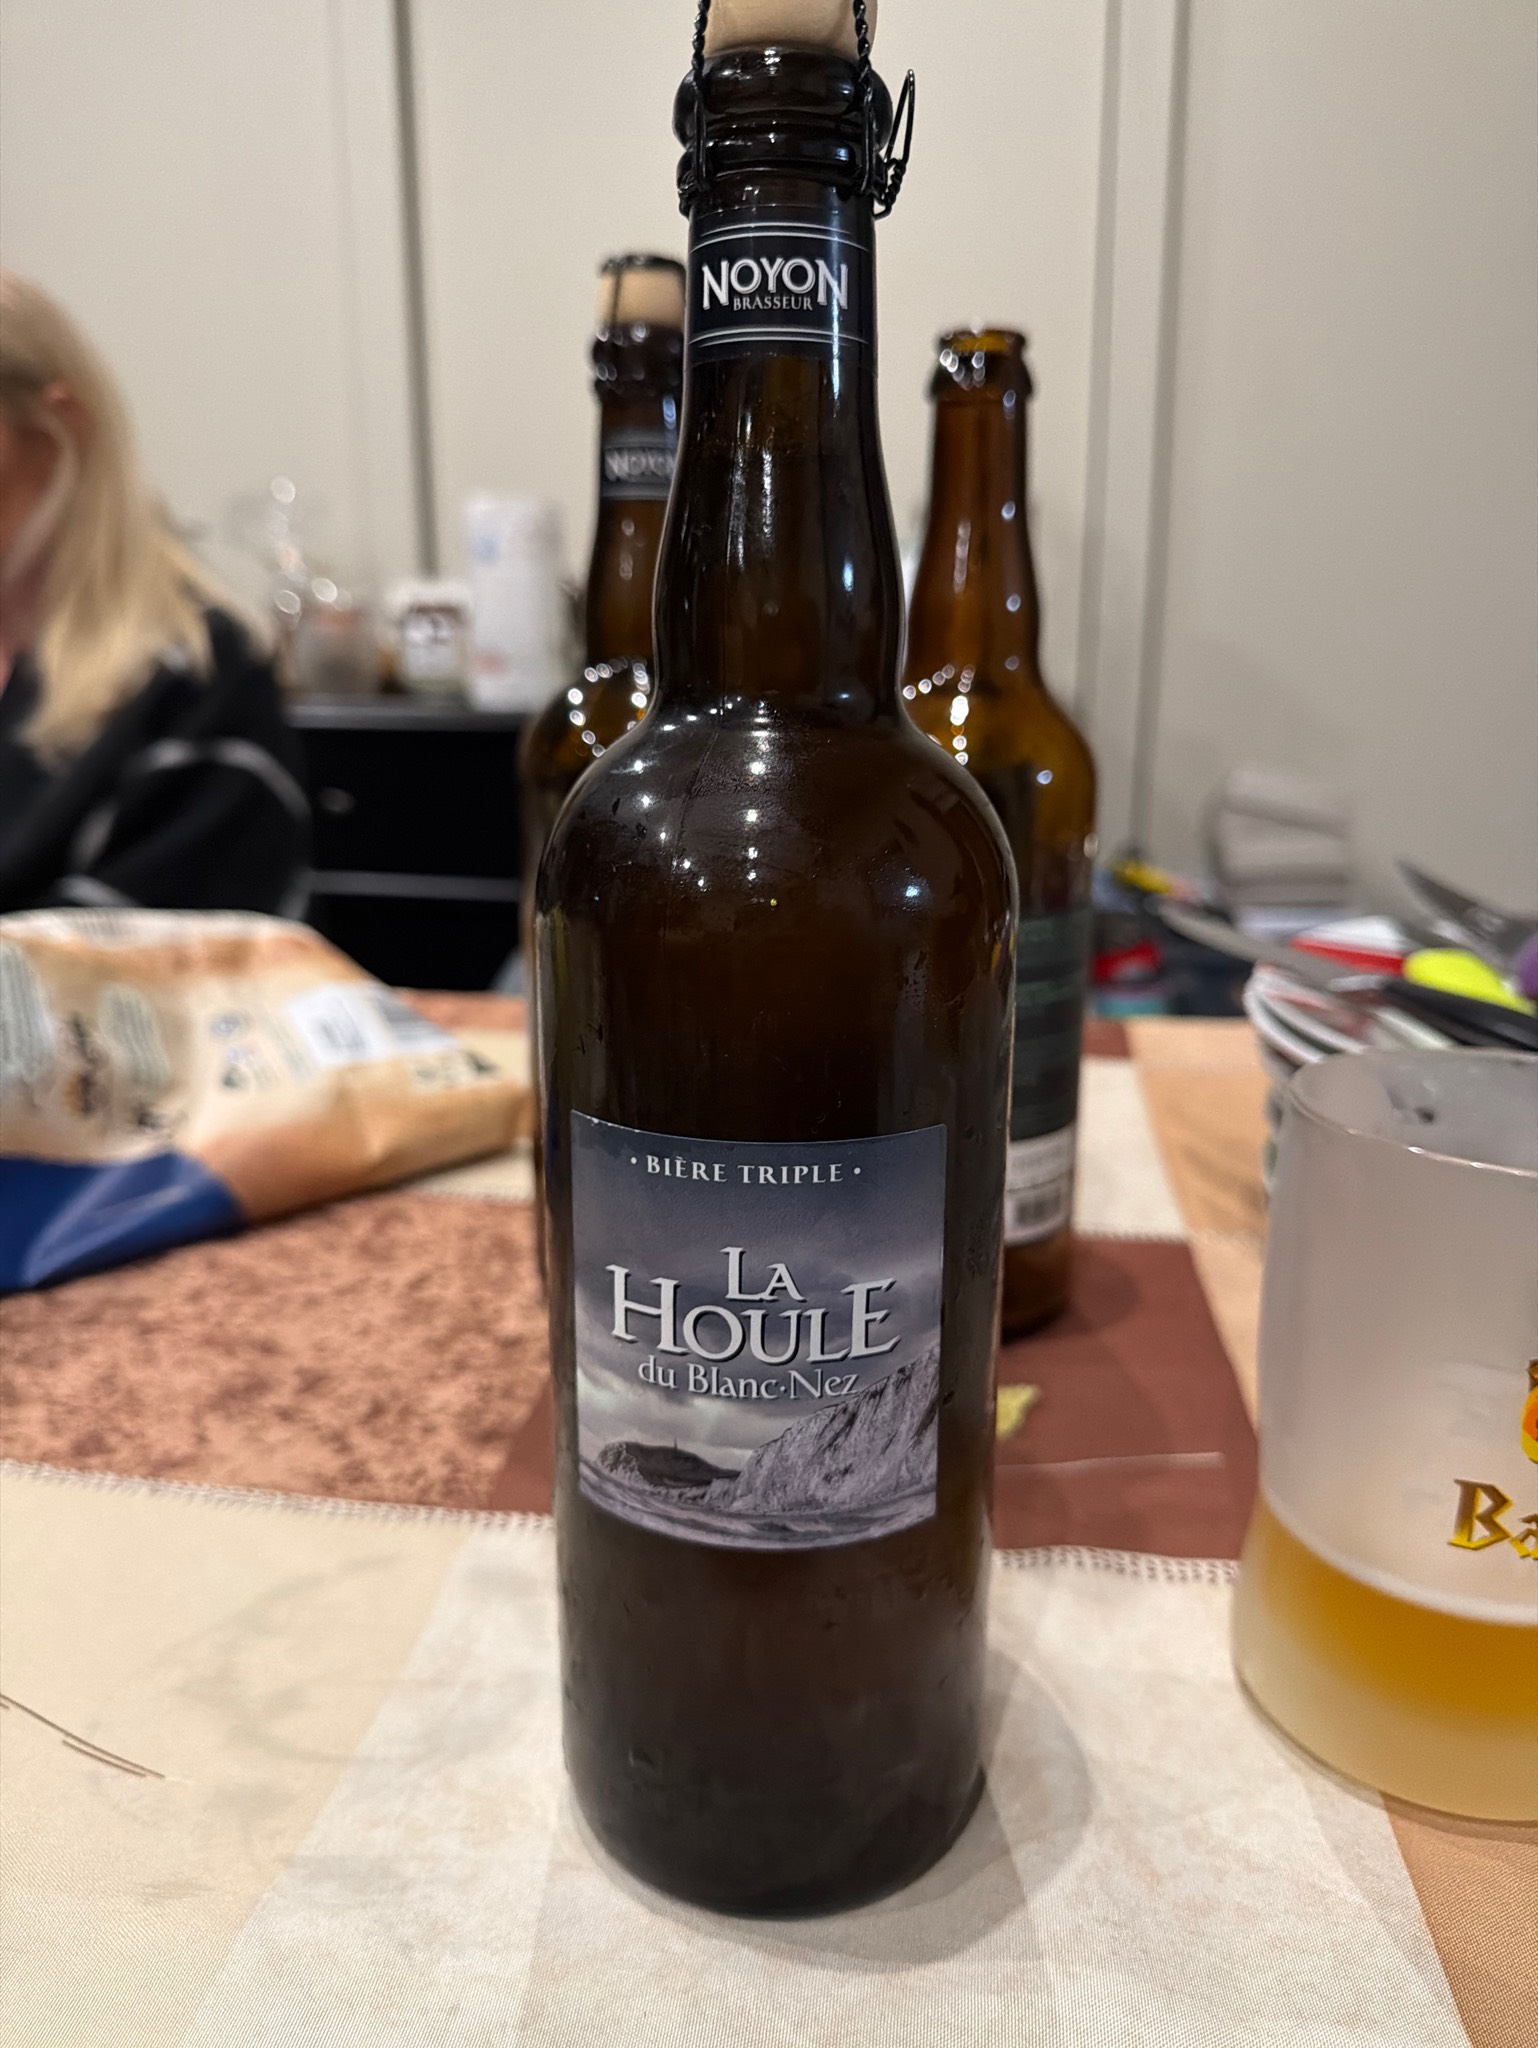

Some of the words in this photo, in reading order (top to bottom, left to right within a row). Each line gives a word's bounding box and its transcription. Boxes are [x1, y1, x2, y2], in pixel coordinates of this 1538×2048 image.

[702, 257, 848, 310] NOYON
[733, 295, 813, 311] BRASSEUR
[646, 1154, 727, 1183] BIÈRE
[737, 1163, 843, 1184] TRIPLE
[605, 1264, 902, 1365] HOULE
[638, 1355, 676, 1389] du
